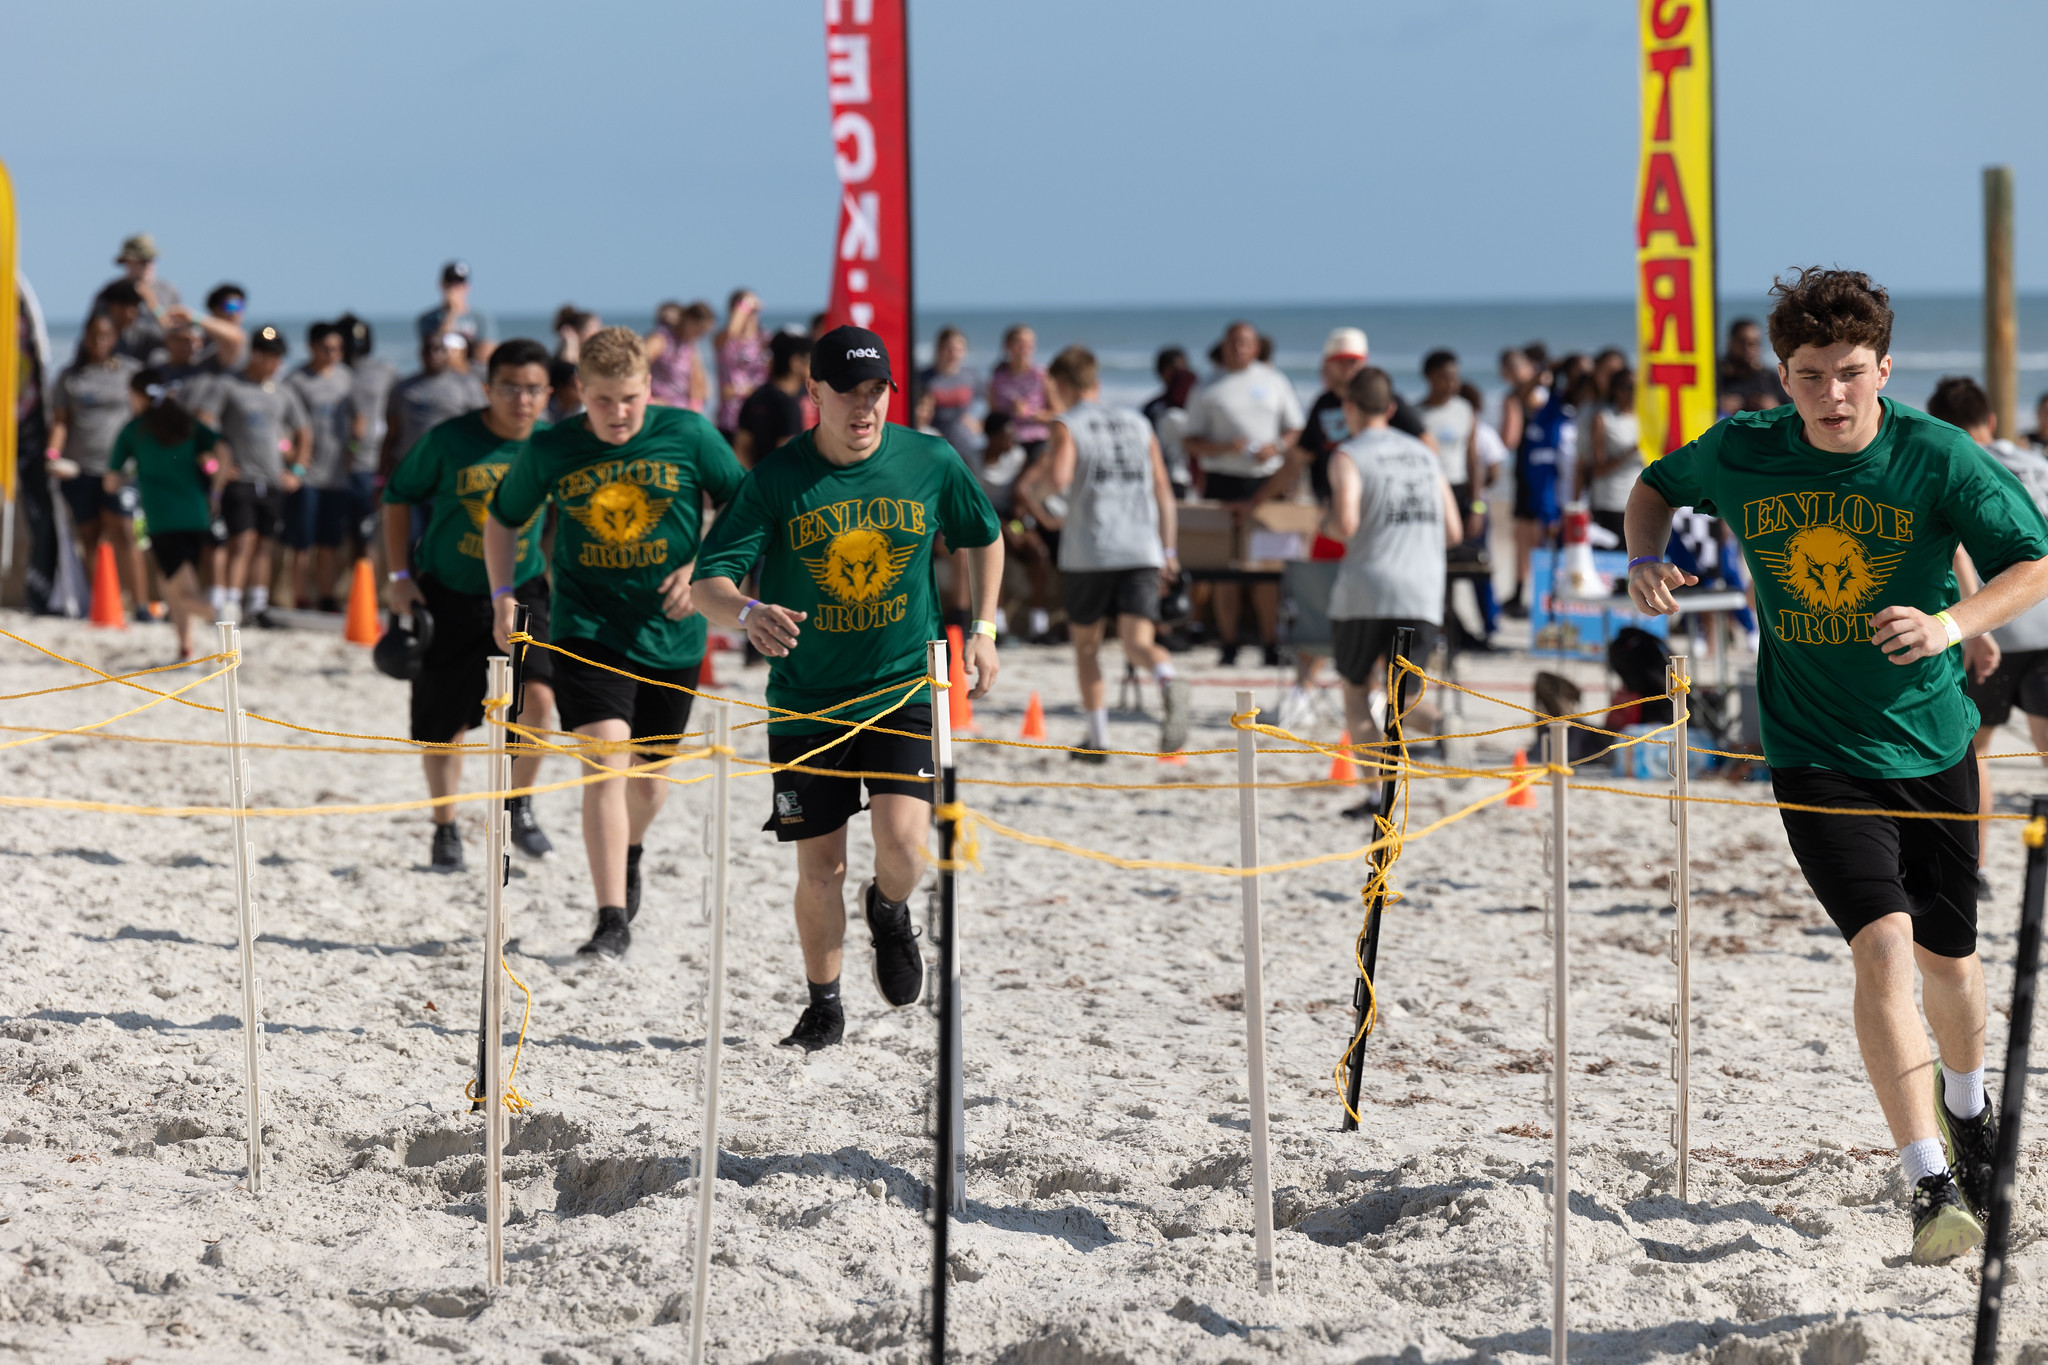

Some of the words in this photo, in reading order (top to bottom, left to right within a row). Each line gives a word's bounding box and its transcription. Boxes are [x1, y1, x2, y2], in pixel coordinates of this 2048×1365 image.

[558, 458, 680, 501] ENLOE
[788, 497, 926, 551] ENLOE
[1743, 491, 1914, 542] ENLOE
[578, 537, 669, 569] JROTC
[814, 594, 908, 632] JROTC
[1774, 609, 1877, 645] JROT
